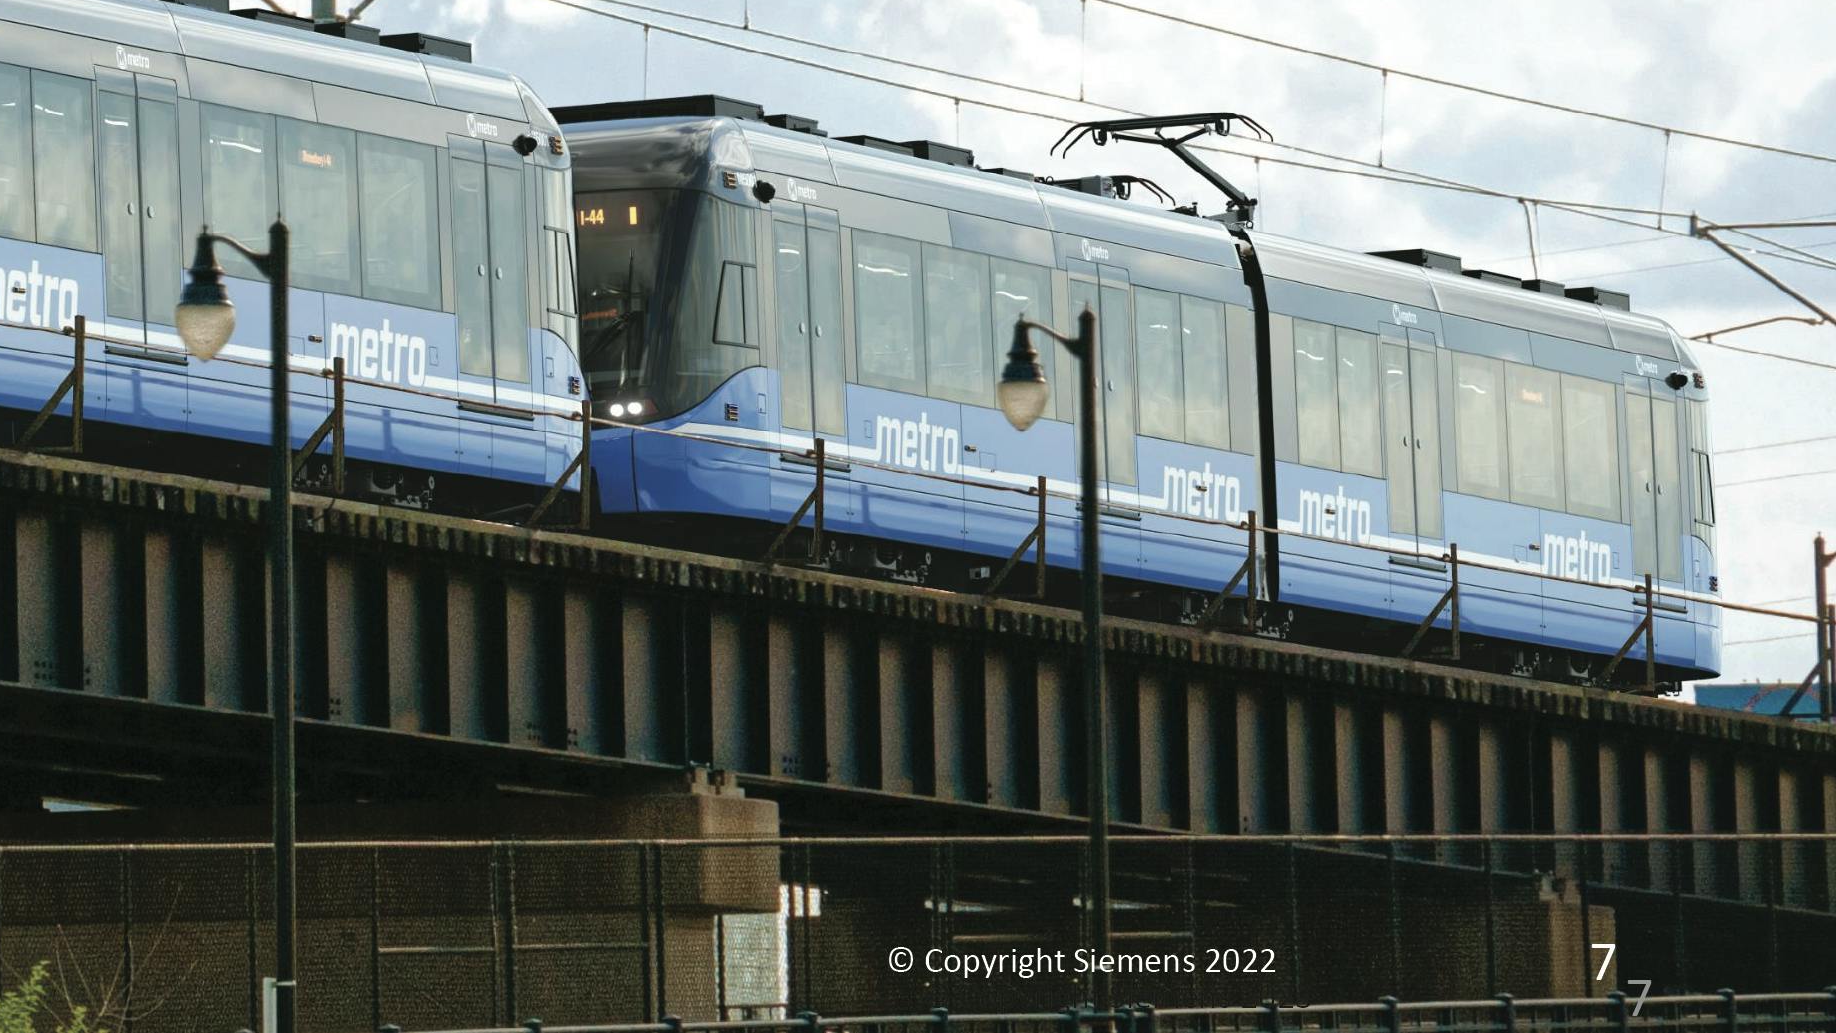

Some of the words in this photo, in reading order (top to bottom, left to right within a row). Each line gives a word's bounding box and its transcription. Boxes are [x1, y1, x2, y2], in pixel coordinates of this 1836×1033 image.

[127, 53, 150, 69] metro
[477, 121, 498, 137] metro
[580, 209, 604, 226] I-44
[329, 319, 427, 388] metro
[875, 412, 960, 474] metro
[1163, 461, 1241, 523] metro
[1298, 485, 1372, 544] metro
[1543, 528, 1612, 586] metro
